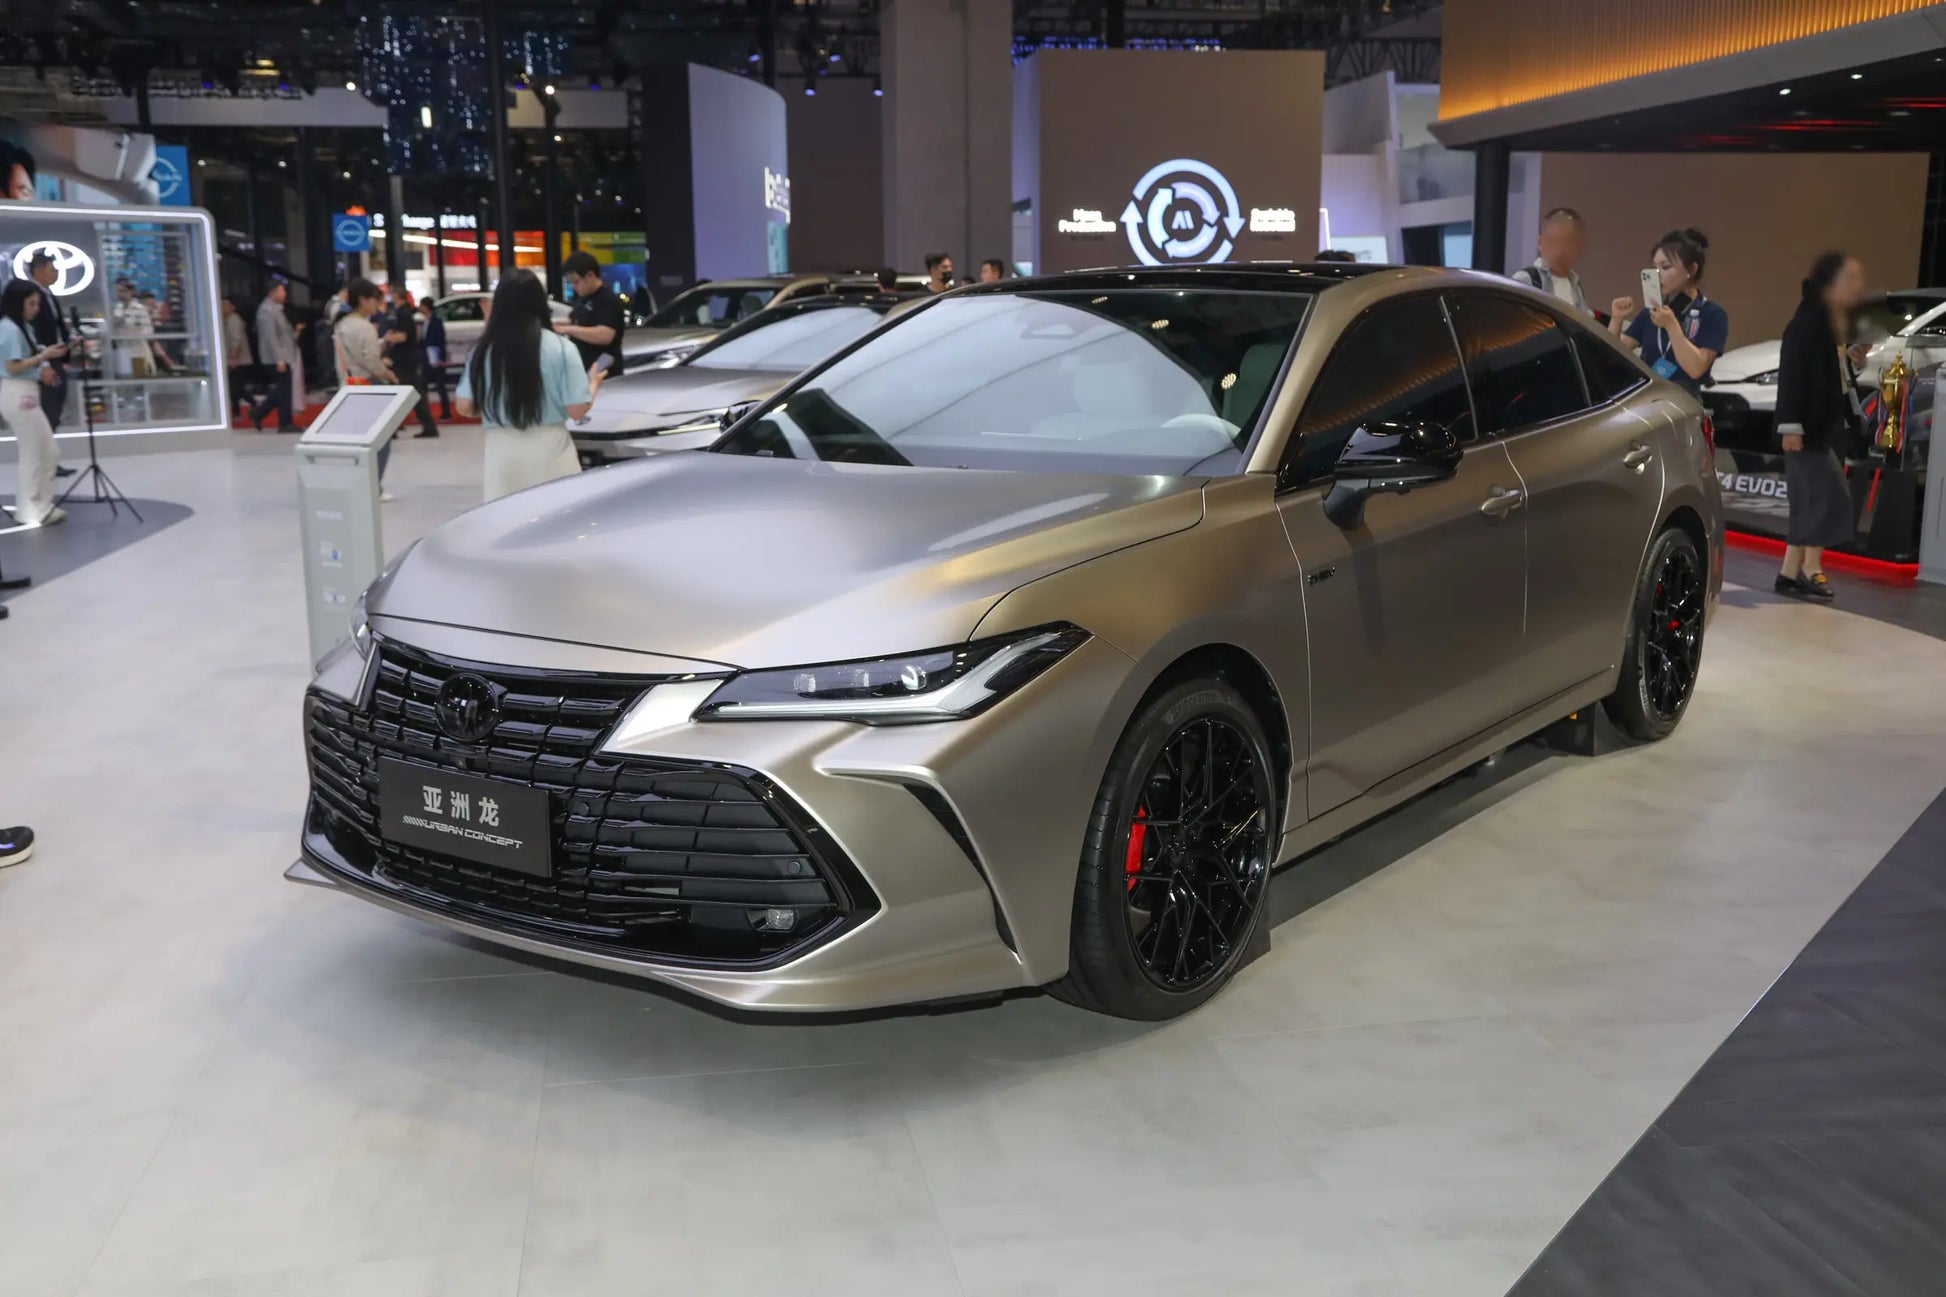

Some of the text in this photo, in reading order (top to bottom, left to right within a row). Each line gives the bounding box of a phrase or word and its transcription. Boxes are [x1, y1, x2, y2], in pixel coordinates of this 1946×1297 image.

[422, 785, 500, 827] 亚洲龙
[424, 819, 523, 848] URBAN CONCEPT
